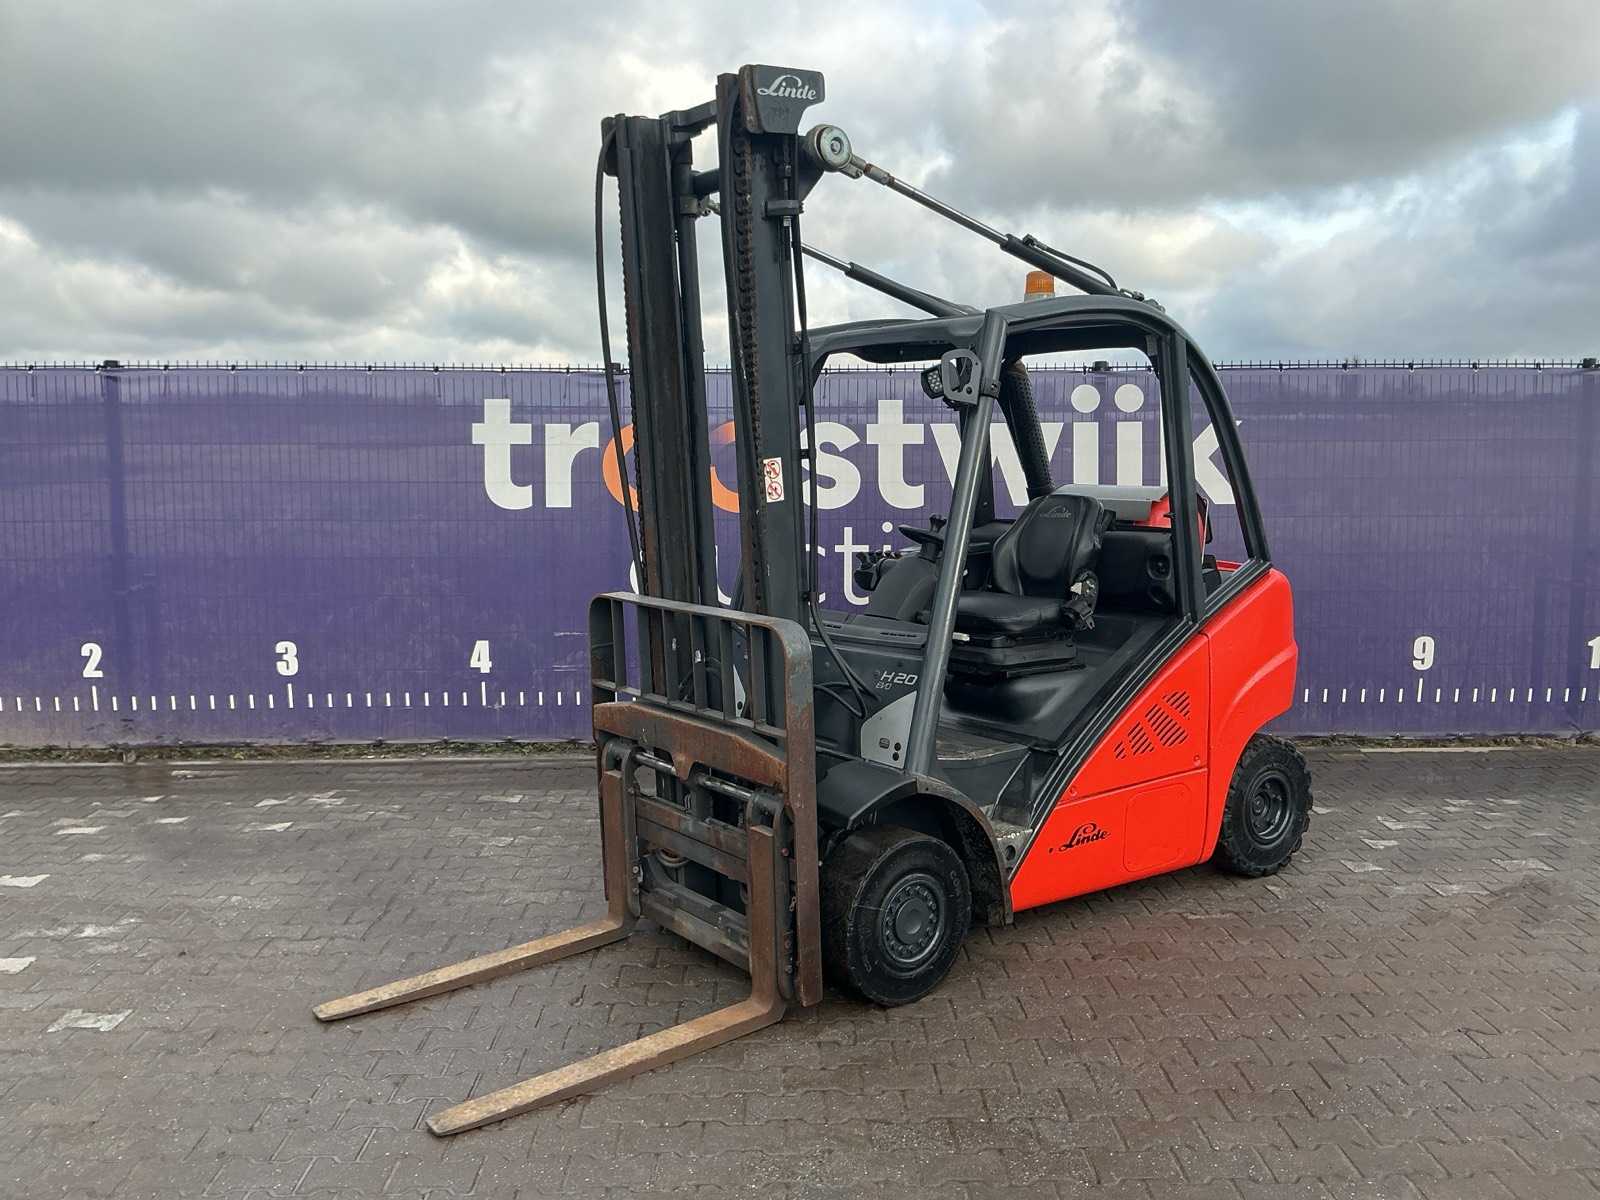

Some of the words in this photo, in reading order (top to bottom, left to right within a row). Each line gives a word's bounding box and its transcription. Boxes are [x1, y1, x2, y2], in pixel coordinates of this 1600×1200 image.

[757, 75, 817, 100] Linde
[80, 642, 104, 678] 2
[275, 640, 299, 676] 3
[469, 639, 493, 674] 4
[1412, 635, 1435, 671] 9
[1059, 822, 1111, 852] Linde
